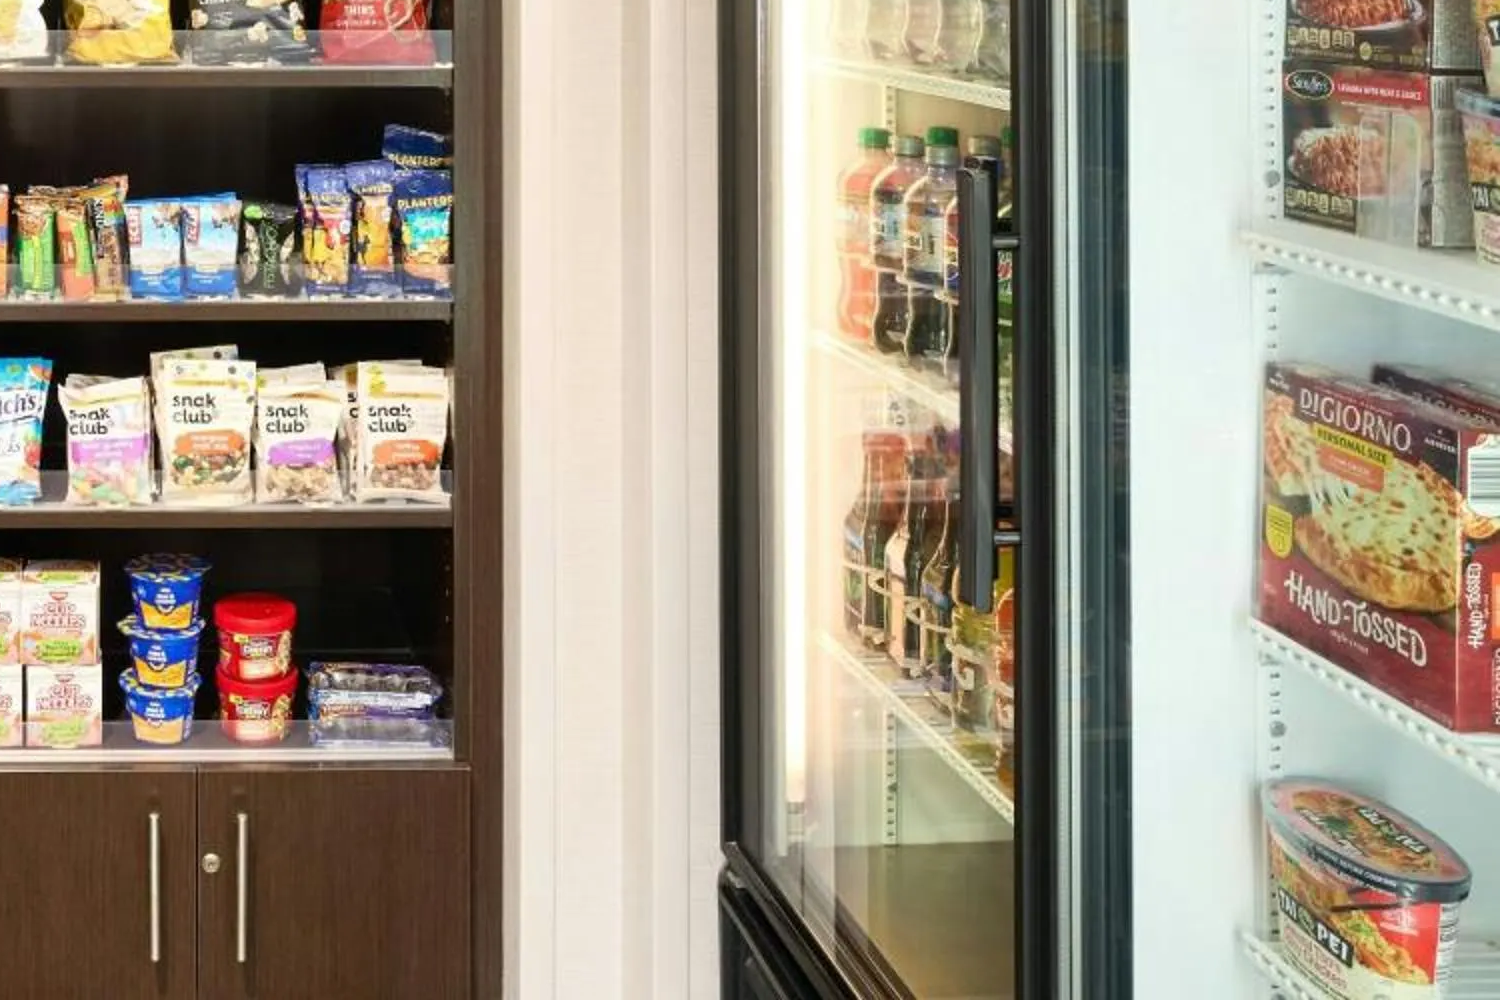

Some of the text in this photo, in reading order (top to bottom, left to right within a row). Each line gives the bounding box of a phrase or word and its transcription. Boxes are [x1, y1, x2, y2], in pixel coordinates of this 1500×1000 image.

[172, 392, 216, 408] snak
[172, 408, 213, 424] club
[265, 404, 309, 419] snak
[265, 419, 305, 434] club
[367, 420, 408, 434] club
[1300, 387, 1413, 452] DIGIORNO
[69, 421, 109, 436] club
[1283, 570, 1427, 668] HAND-TOSSED
